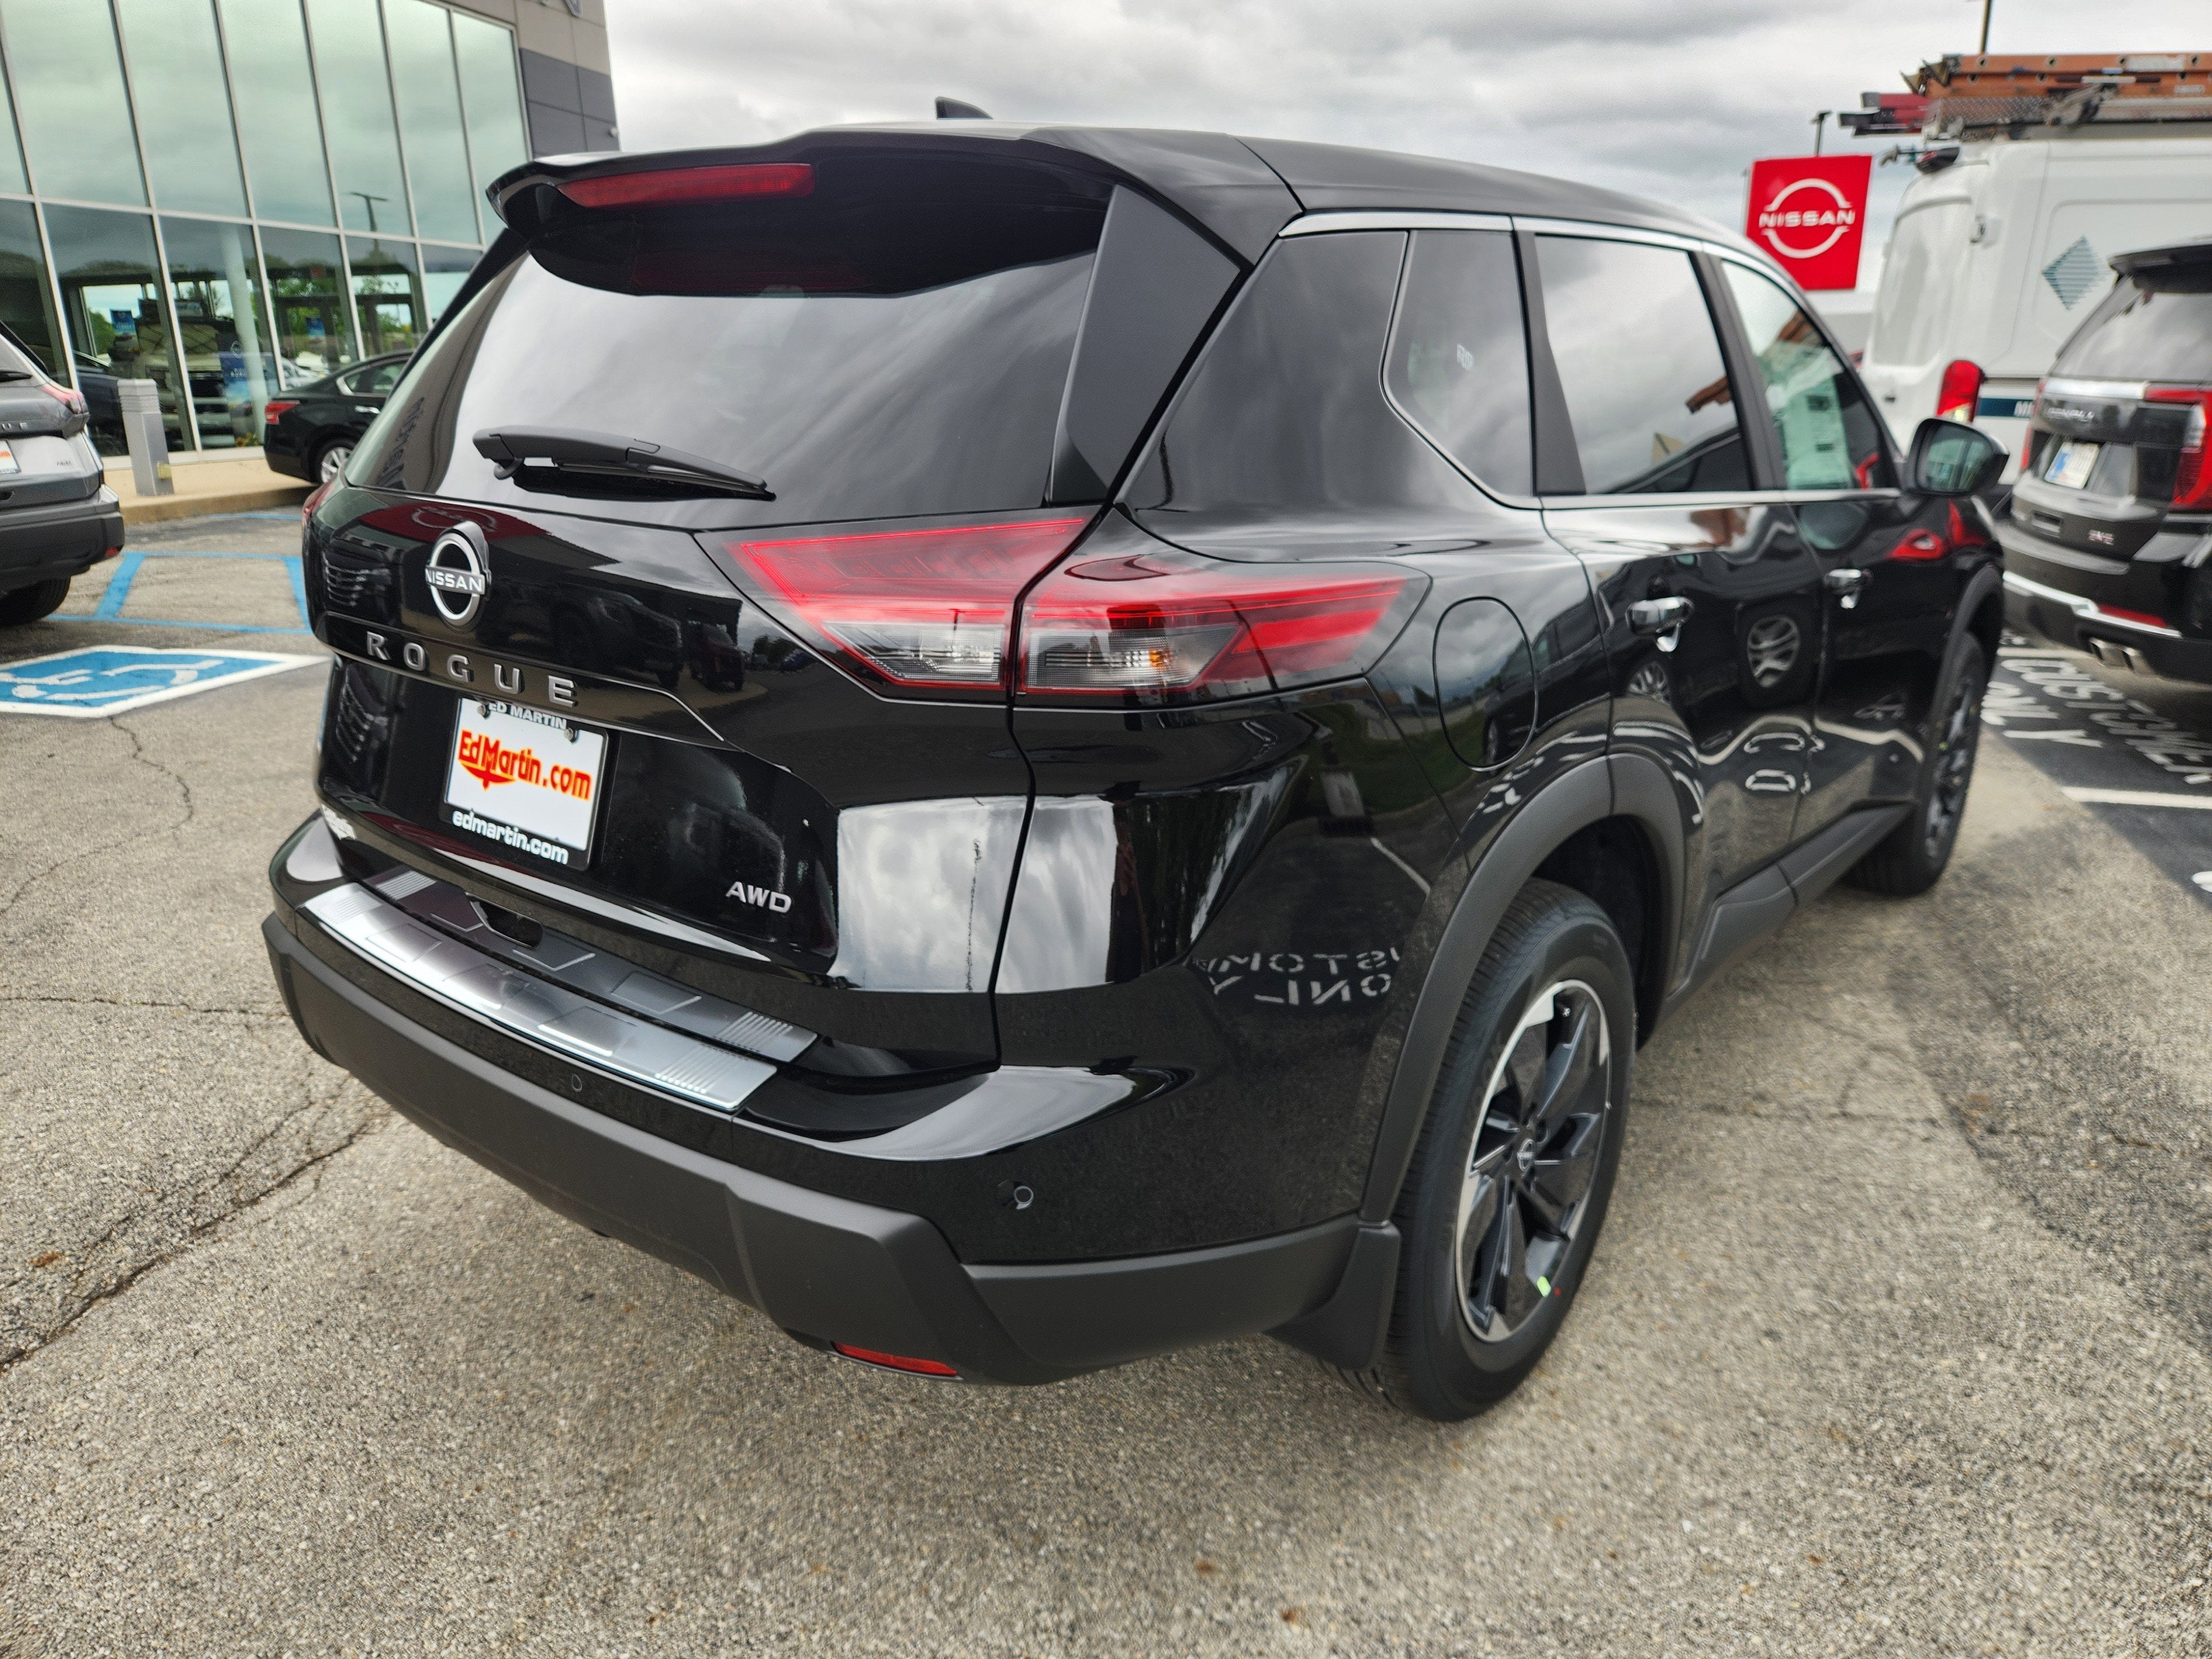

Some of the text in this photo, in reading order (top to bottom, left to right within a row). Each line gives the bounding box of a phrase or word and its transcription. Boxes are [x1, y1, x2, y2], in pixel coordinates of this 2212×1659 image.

[1759, 210, 1855, 228] NISSAN
[425, 568, 482, 592] NISSAN
[367, 631, 576, 708] ROGUE
[488, 701, 567, 731] ED MARTIN
[458, 729, 592, 802] EdMartin.com
[452, 810, 569, 865] edmartin.com
[726, 881, 791, 913] AWD
